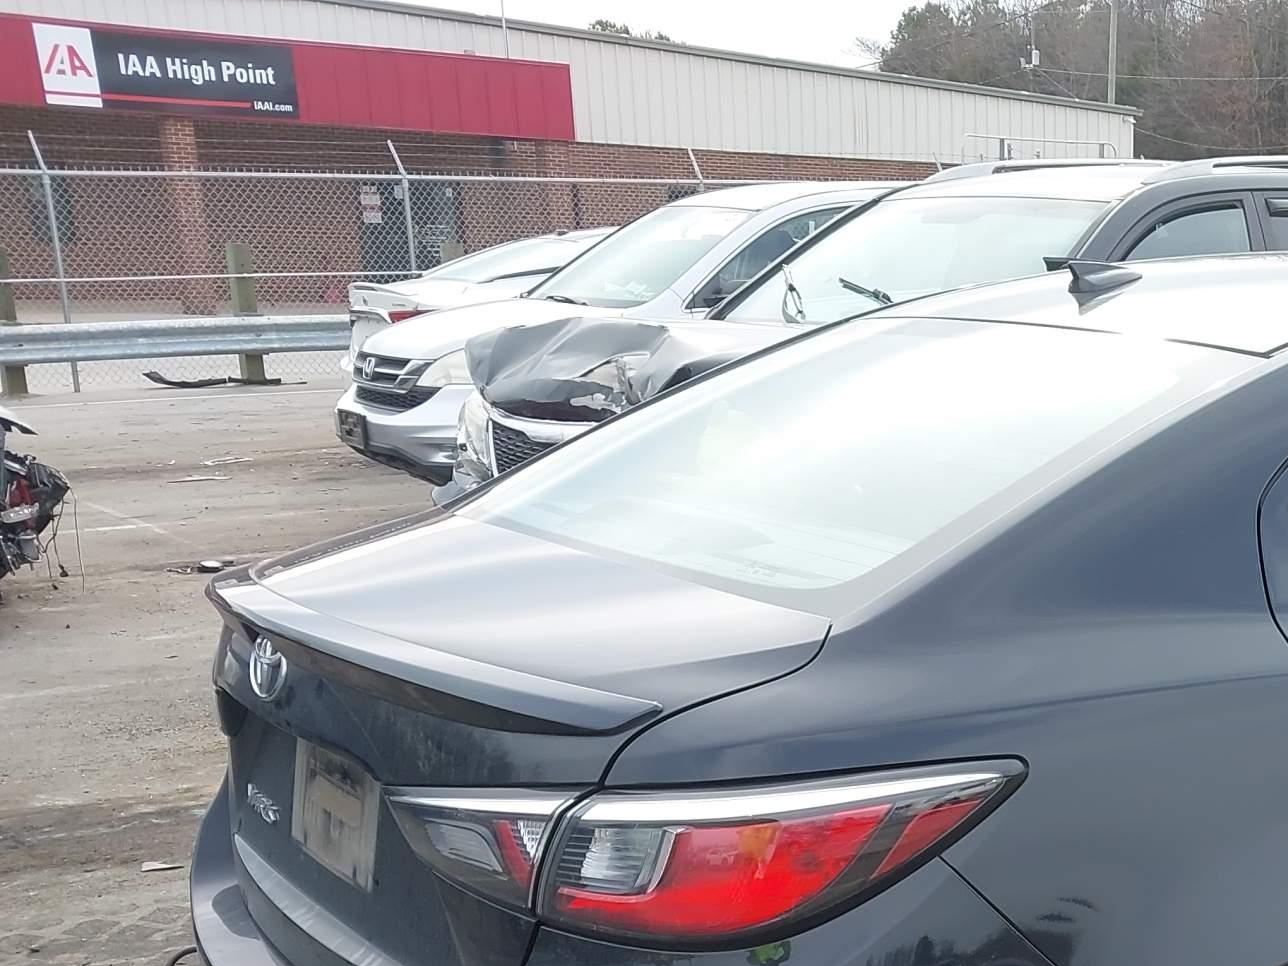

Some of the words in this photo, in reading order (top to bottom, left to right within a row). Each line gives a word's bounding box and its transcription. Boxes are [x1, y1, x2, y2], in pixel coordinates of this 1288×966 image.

[117, 53, 161, 78] IAA
[166, 57, 216, 85] High
[220, 61, 276, 85] Point
[253, 100, 293, 112] IAAI.com
